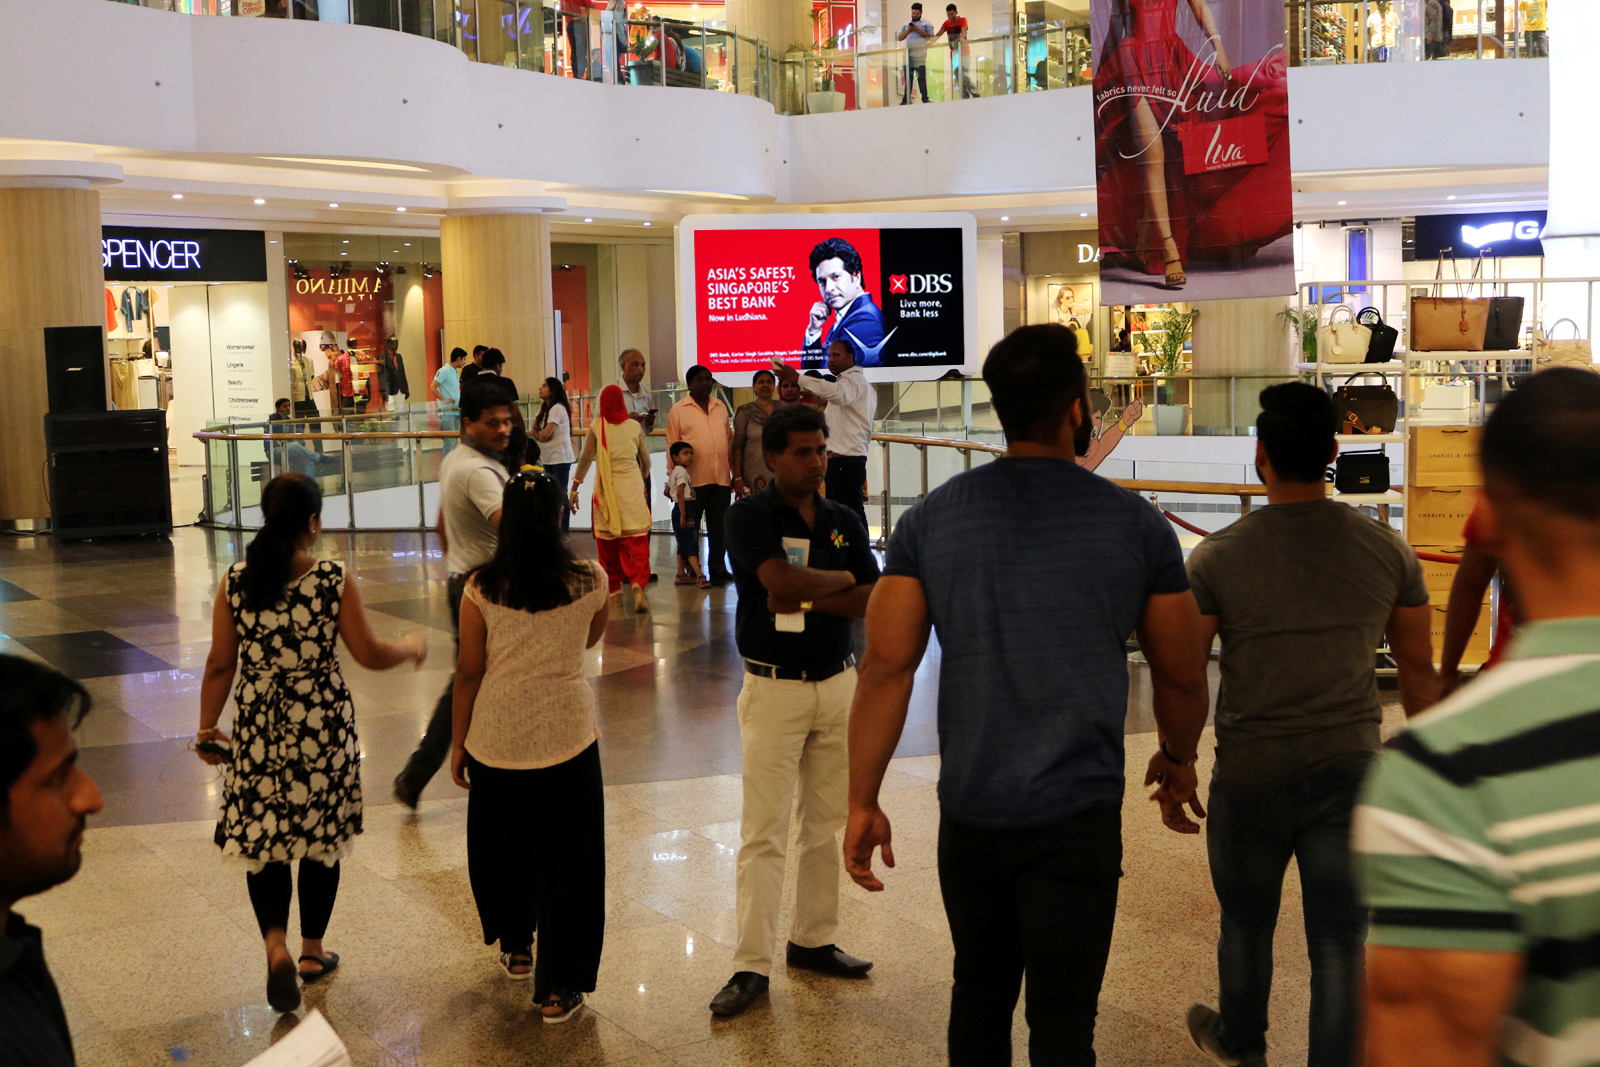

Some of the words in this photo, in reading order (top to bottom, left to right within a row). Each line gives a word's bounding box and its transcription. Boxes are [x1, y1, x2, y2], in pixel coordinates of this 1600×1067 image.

[1096, 86, 1126, 102] fabrics
[1152, 85, 1166, 94] felt
[1098, 34, 1284, 158] fluid
[1515, 220, 1546, 240] G
[102, 238, 201, 269] SPENCER
[707, 267, 747, 281] ASIA'S
[749, 266, 796, 280] SAFEST,
[707, 281, 790, 295] SINGAPORE'S
[910, 274, 953, 293] DBS
[708, 297, 738, 309] BEST
[741, 296, 776, 308] BANK
[900, 299, 916, 308] Live
[735, 313, 768, 321] Ludhiana.
[900, 309, 920, 318] Bank
[923, 309, 939, 317] less
